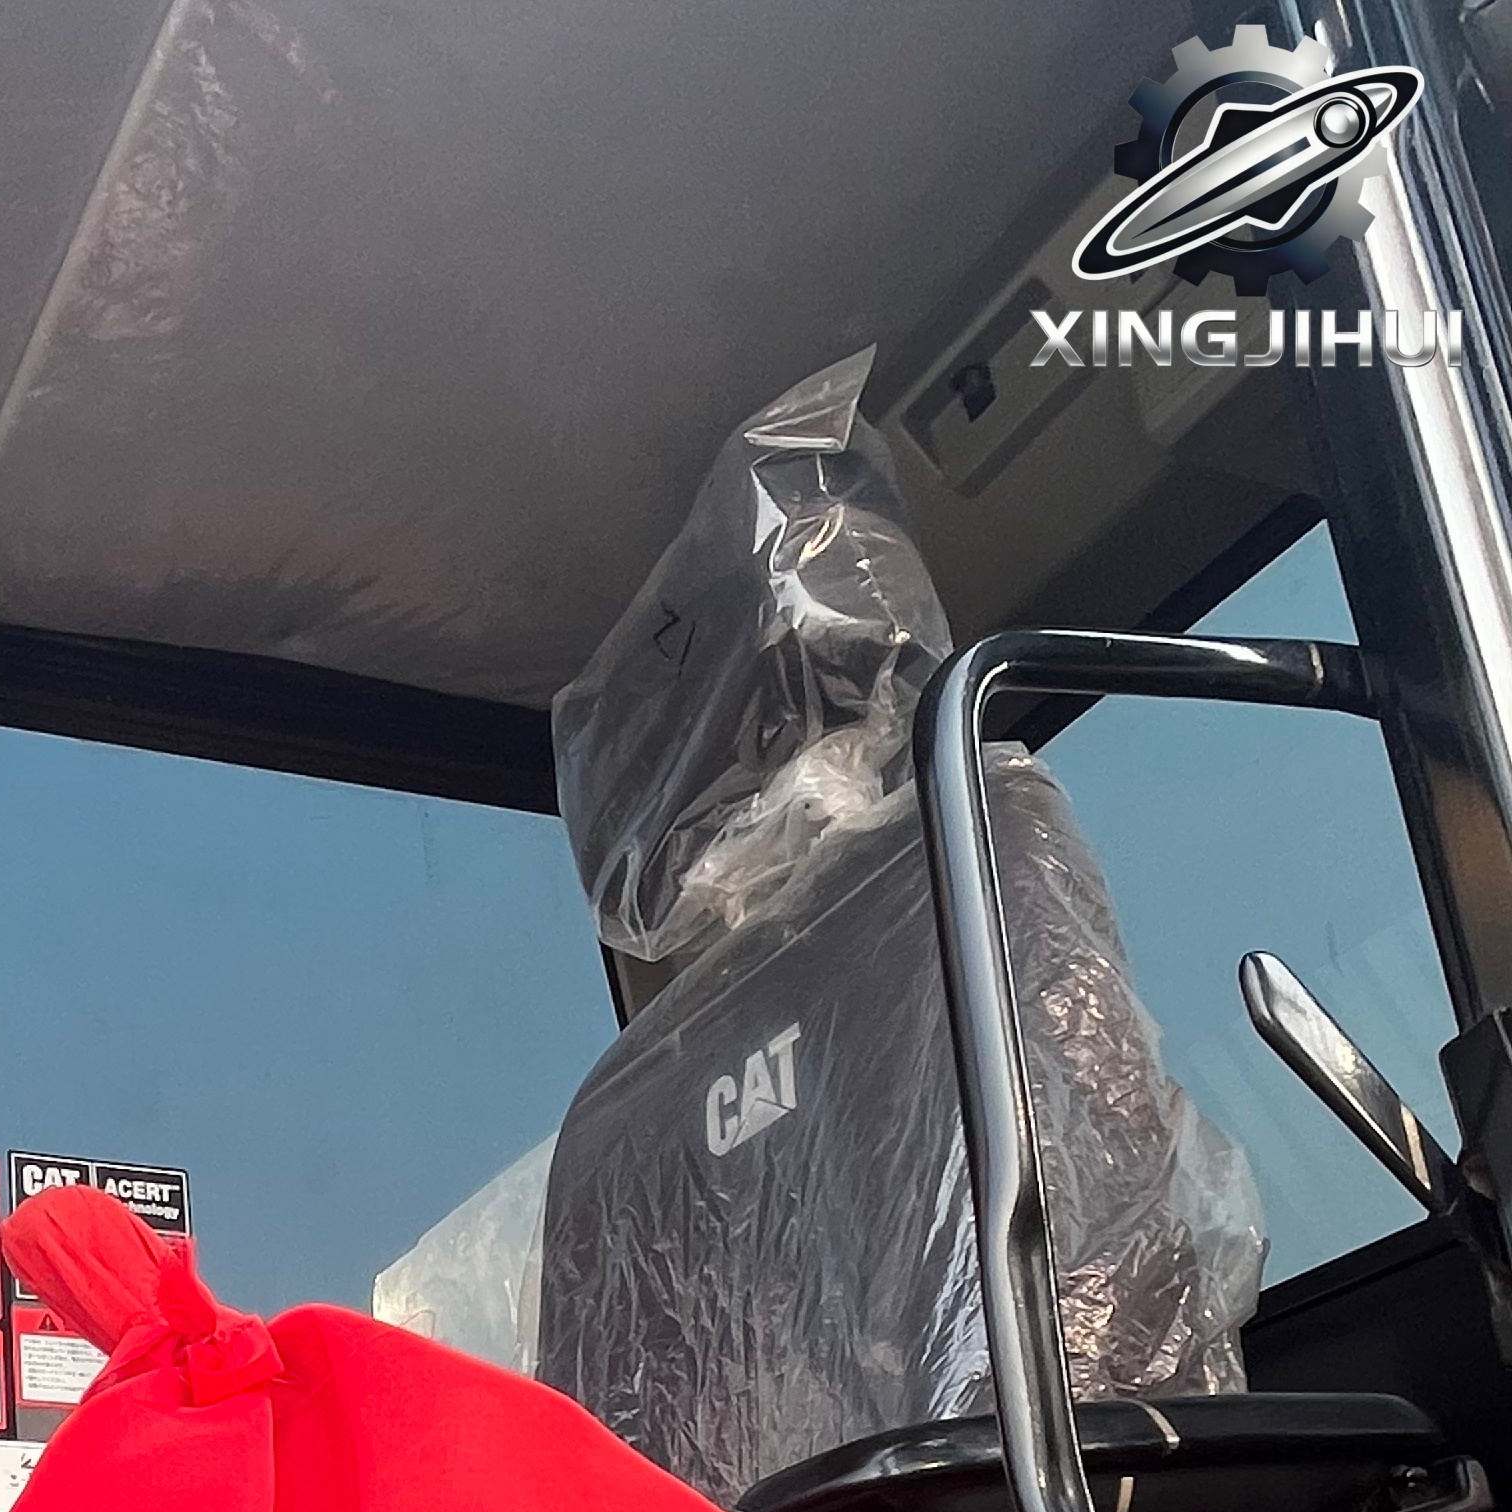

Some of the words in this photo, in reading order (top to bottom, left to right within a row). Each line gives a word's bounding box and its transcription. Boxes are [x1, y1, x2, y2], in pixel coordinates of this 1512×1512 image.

[706, 1021, 801, 1157] CAT
[22, 1164, 81, 1197] CAT
[104, 1178, 175, 1202] ACERT
[123, 1200, 180, 1220] hnology
